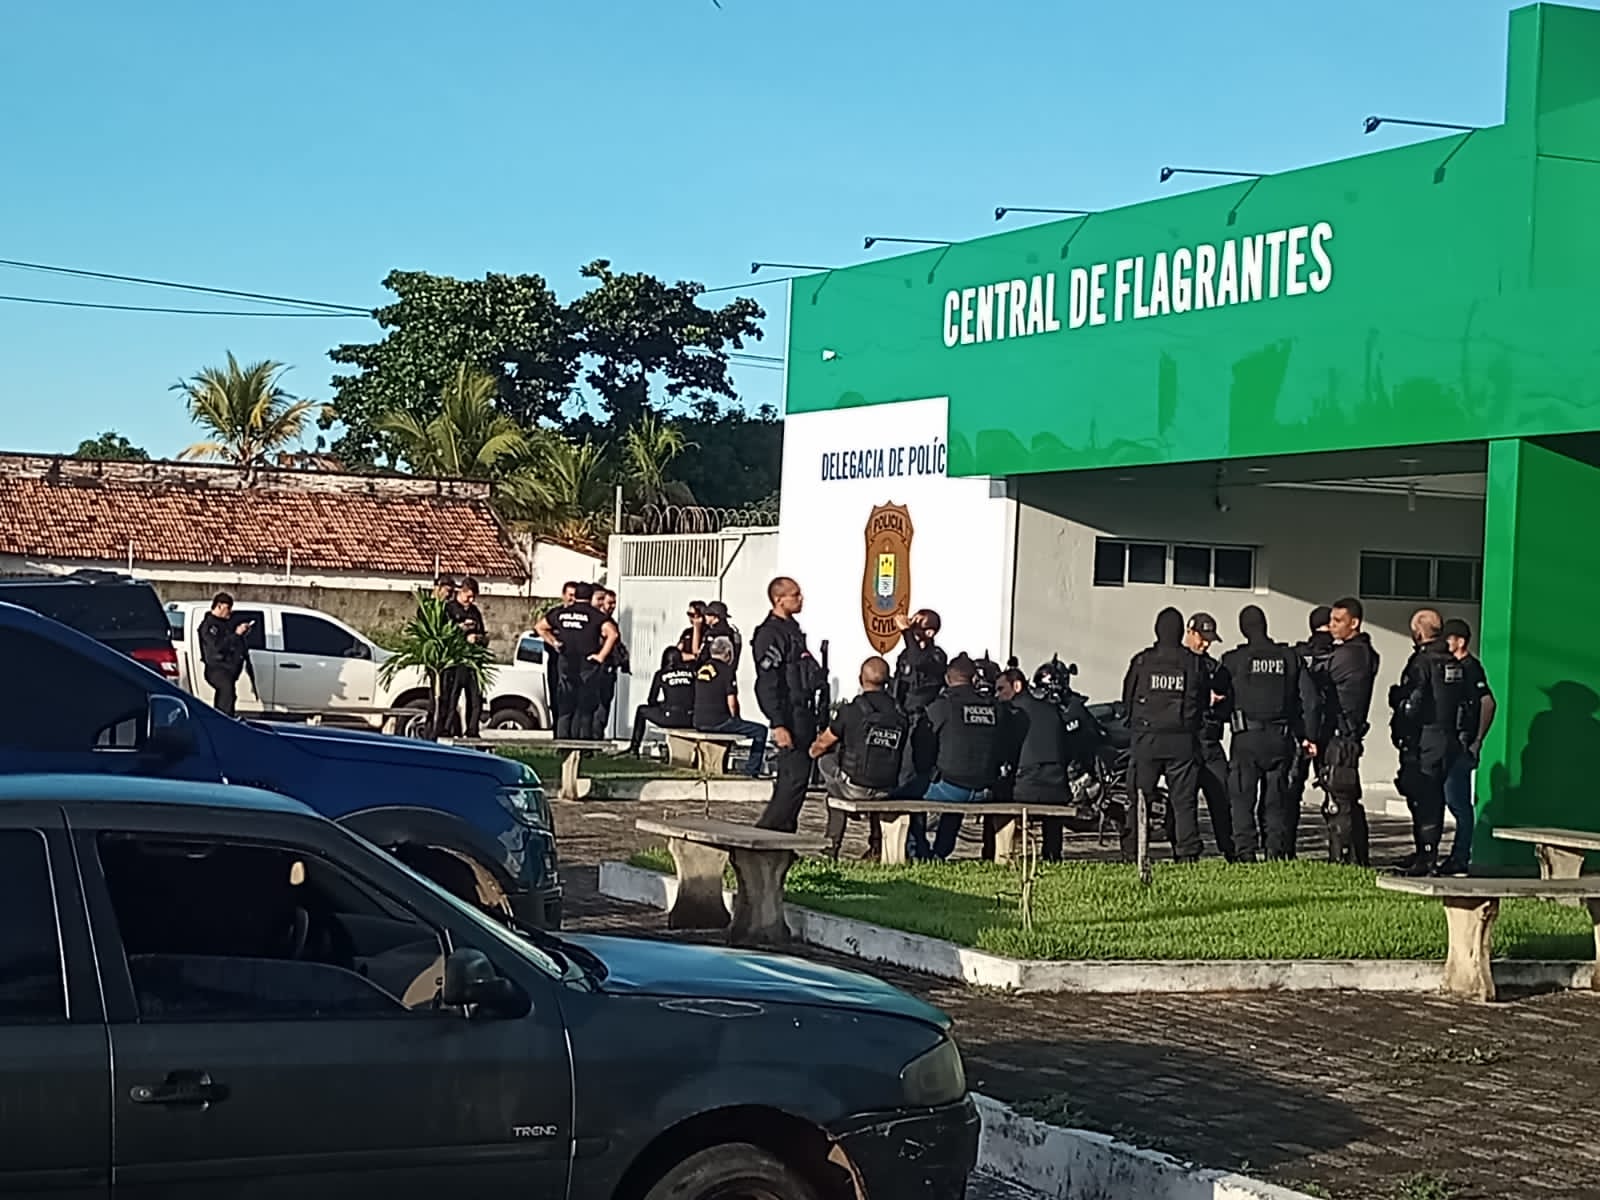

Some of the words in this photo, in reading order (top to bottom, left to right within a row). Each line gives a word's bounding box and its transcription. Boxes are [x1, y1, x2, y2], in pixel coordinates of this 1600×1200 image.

[943, 273, 1060, 347] CENTRAL
[1069, 263, 1108, 329] DE
[1114, 222, 1333, 322] FLAGRANTES
[822, 448, 884, 481] DELEGACIA
[888, 446, 904, 477] DE
[872, 617, 897, 633] CIVIL
[1252, 659, 1284, 674] BOPE
[1151, 675, 1184, 691] BOPE
[512, 1125, 558, 1137] TREND
